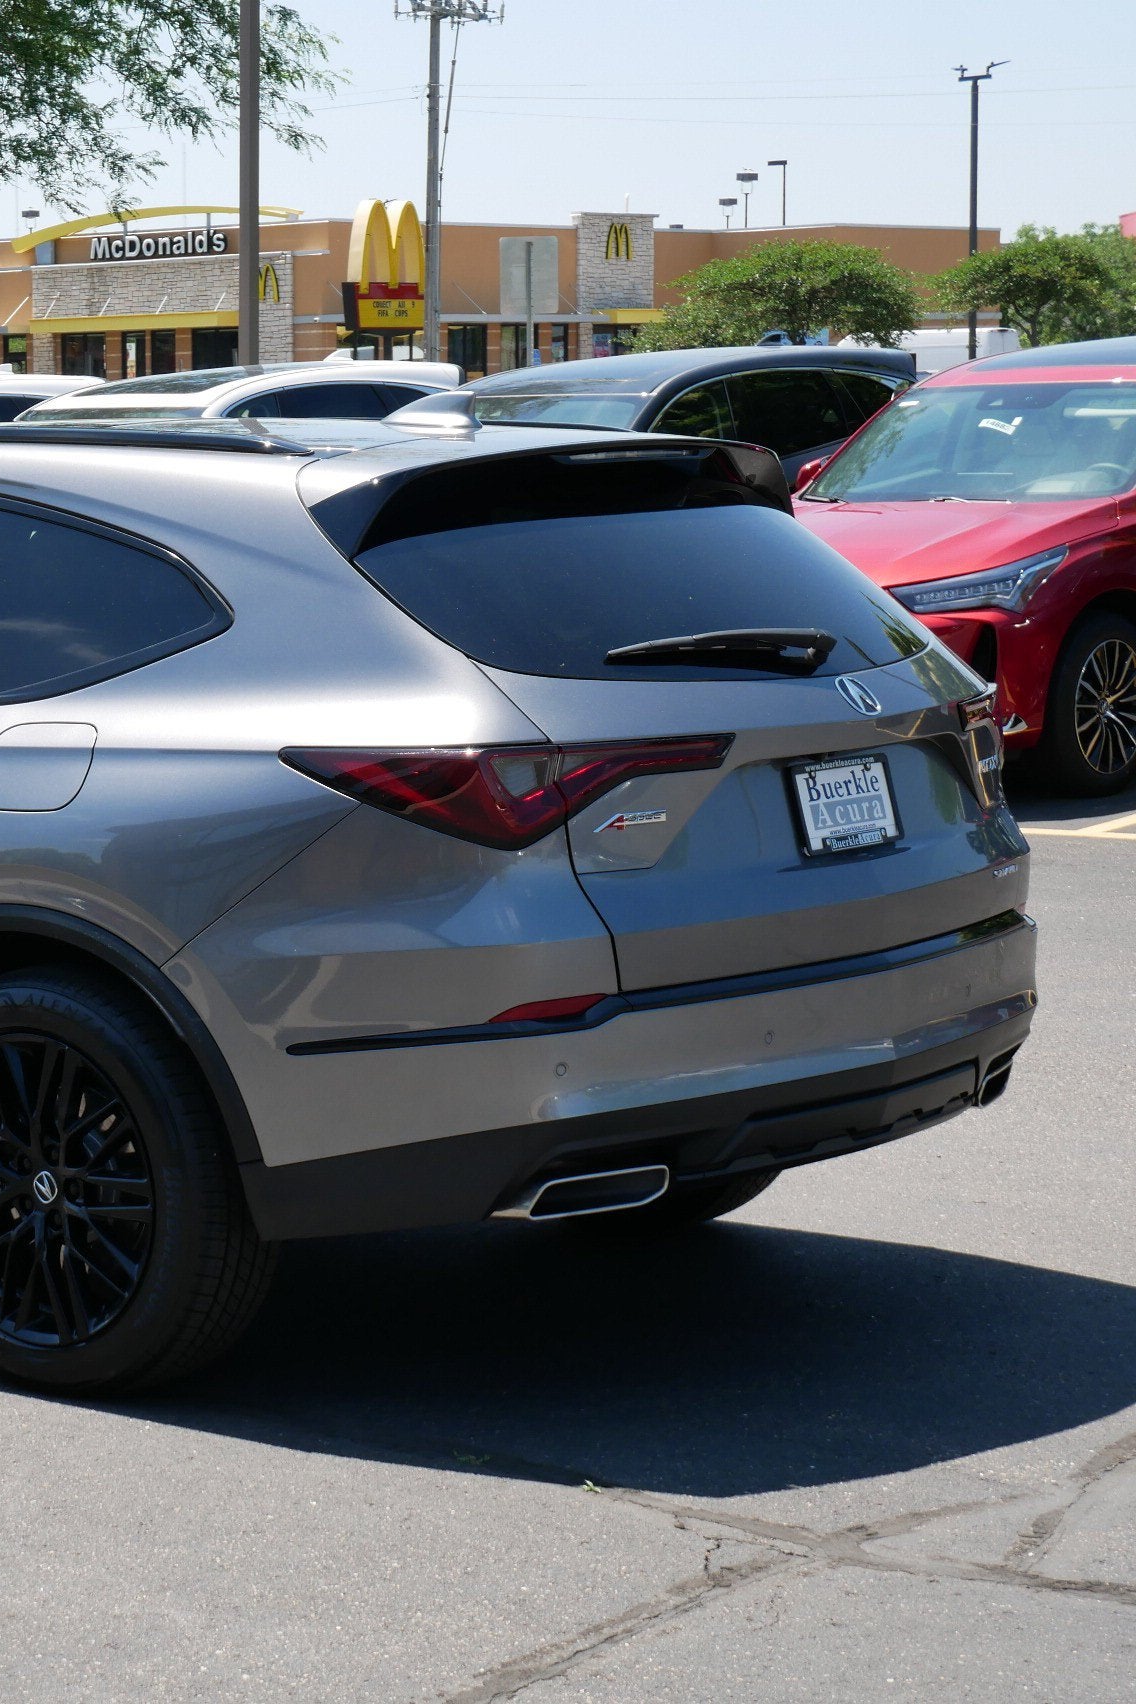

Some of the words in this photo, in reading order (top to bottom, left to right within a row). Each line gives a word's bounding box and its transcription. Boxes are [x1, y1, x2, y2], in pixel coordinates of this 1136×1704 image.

[90, 230, 226, 260] McDonald's
[377, 309, 389, 317] FIFA
[803, 769, 880, 802] Buerkle
[817, 799, 884, 828] Acura
